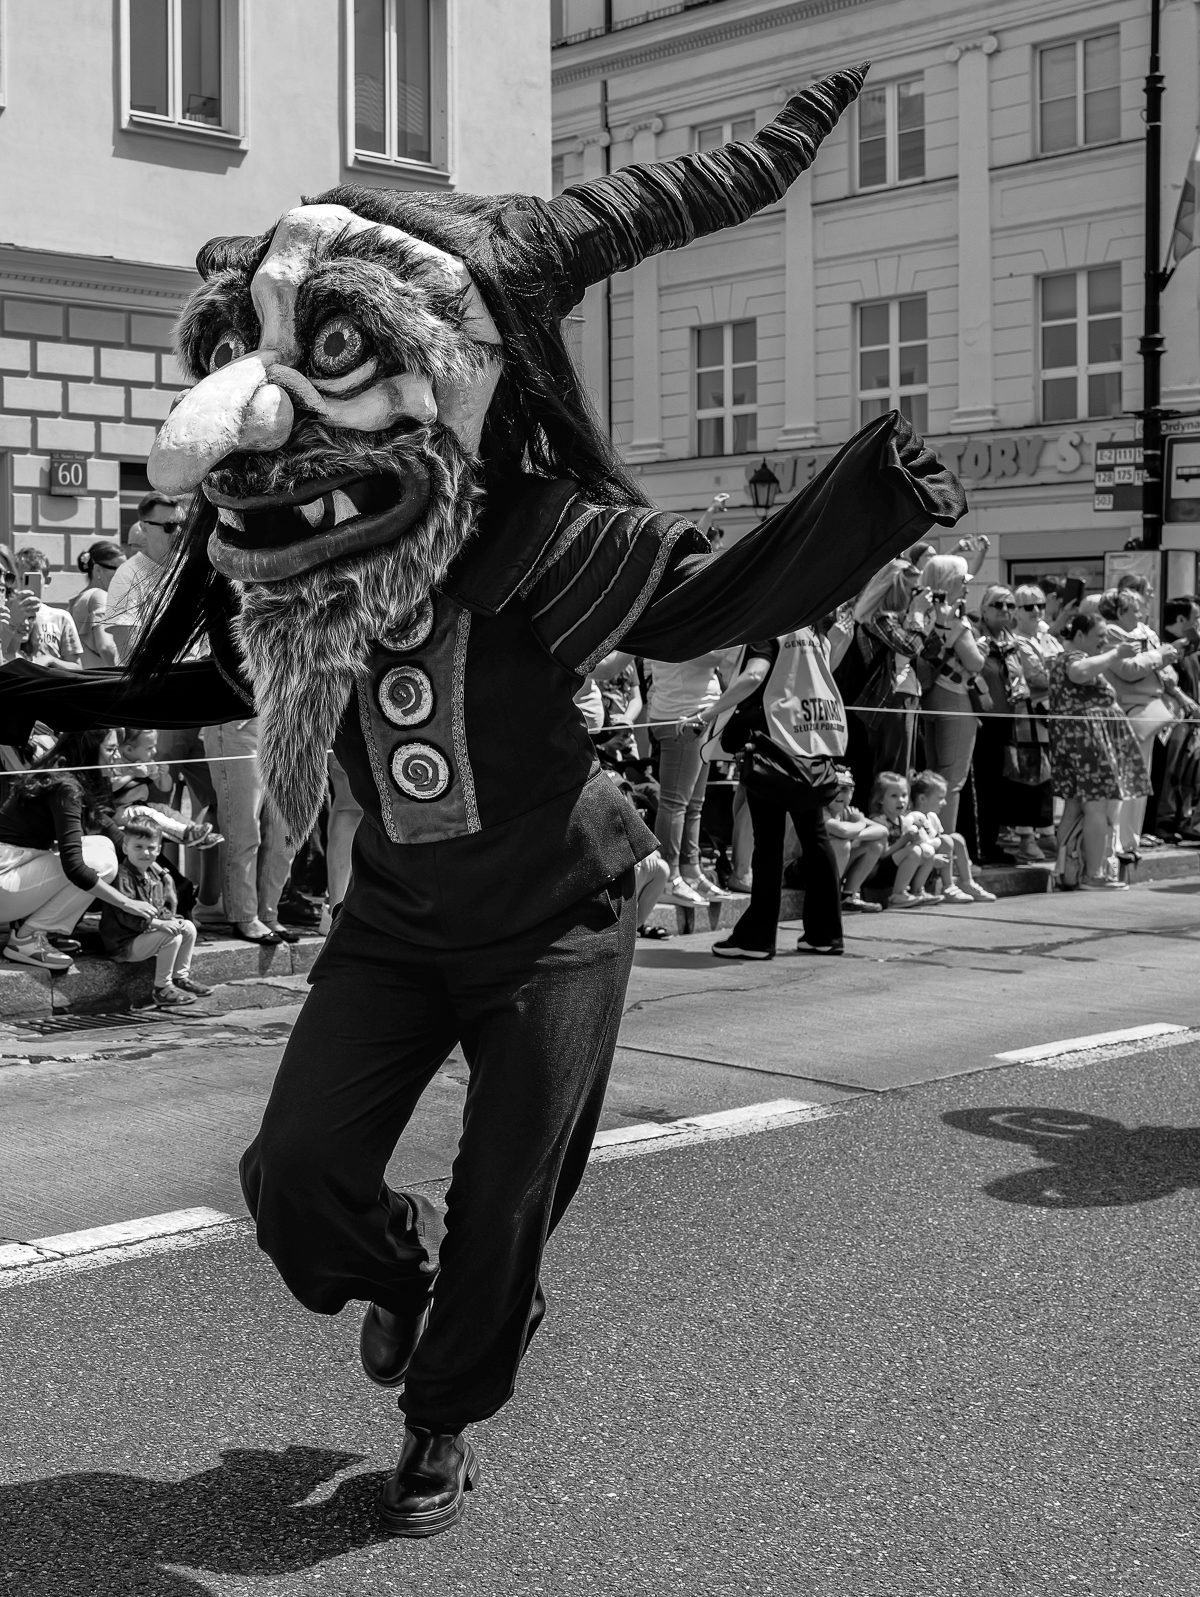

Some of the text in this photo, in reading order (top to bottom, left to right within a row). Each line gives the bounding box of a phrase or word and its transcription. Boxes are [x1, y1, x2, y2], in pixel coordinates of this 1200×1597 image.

[1118, 449, 1133, 460] 111
[58, 462, 83, 486] 60
[1117, 468, 1133, 481] 175
